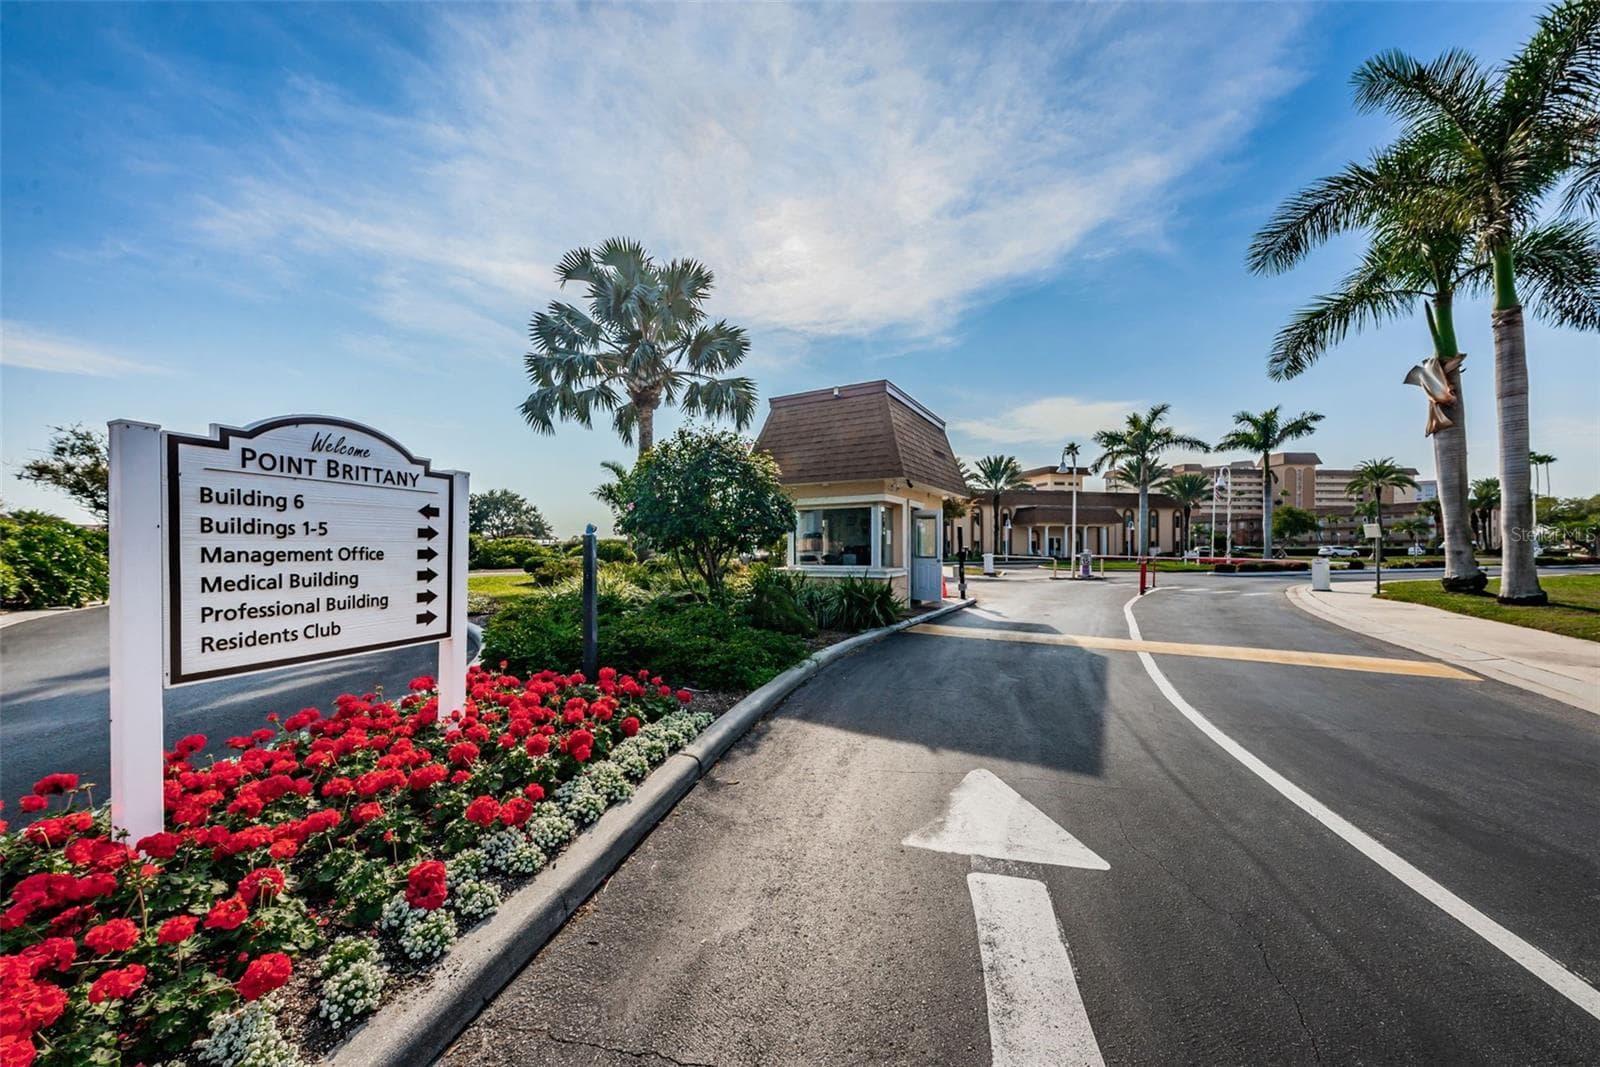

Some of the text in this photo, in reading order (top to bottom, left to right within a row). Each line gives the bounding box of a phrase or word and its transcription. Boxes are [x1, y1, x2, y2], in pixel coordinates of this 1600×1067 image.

[311, 431, 371, 458] Welcome
[240, 447, 420, 488] POINT BRITTANY
[200, 486, 305, 512] Building 6
[200, 516, 329, 539] Buildings 1-5
[200, 546, 385, 566] Management Office
[201, 571, 360, 593] Medical Building
[201, 594, 390, 623] Professional Building
[201, 622, 342, 653] Residents Club
